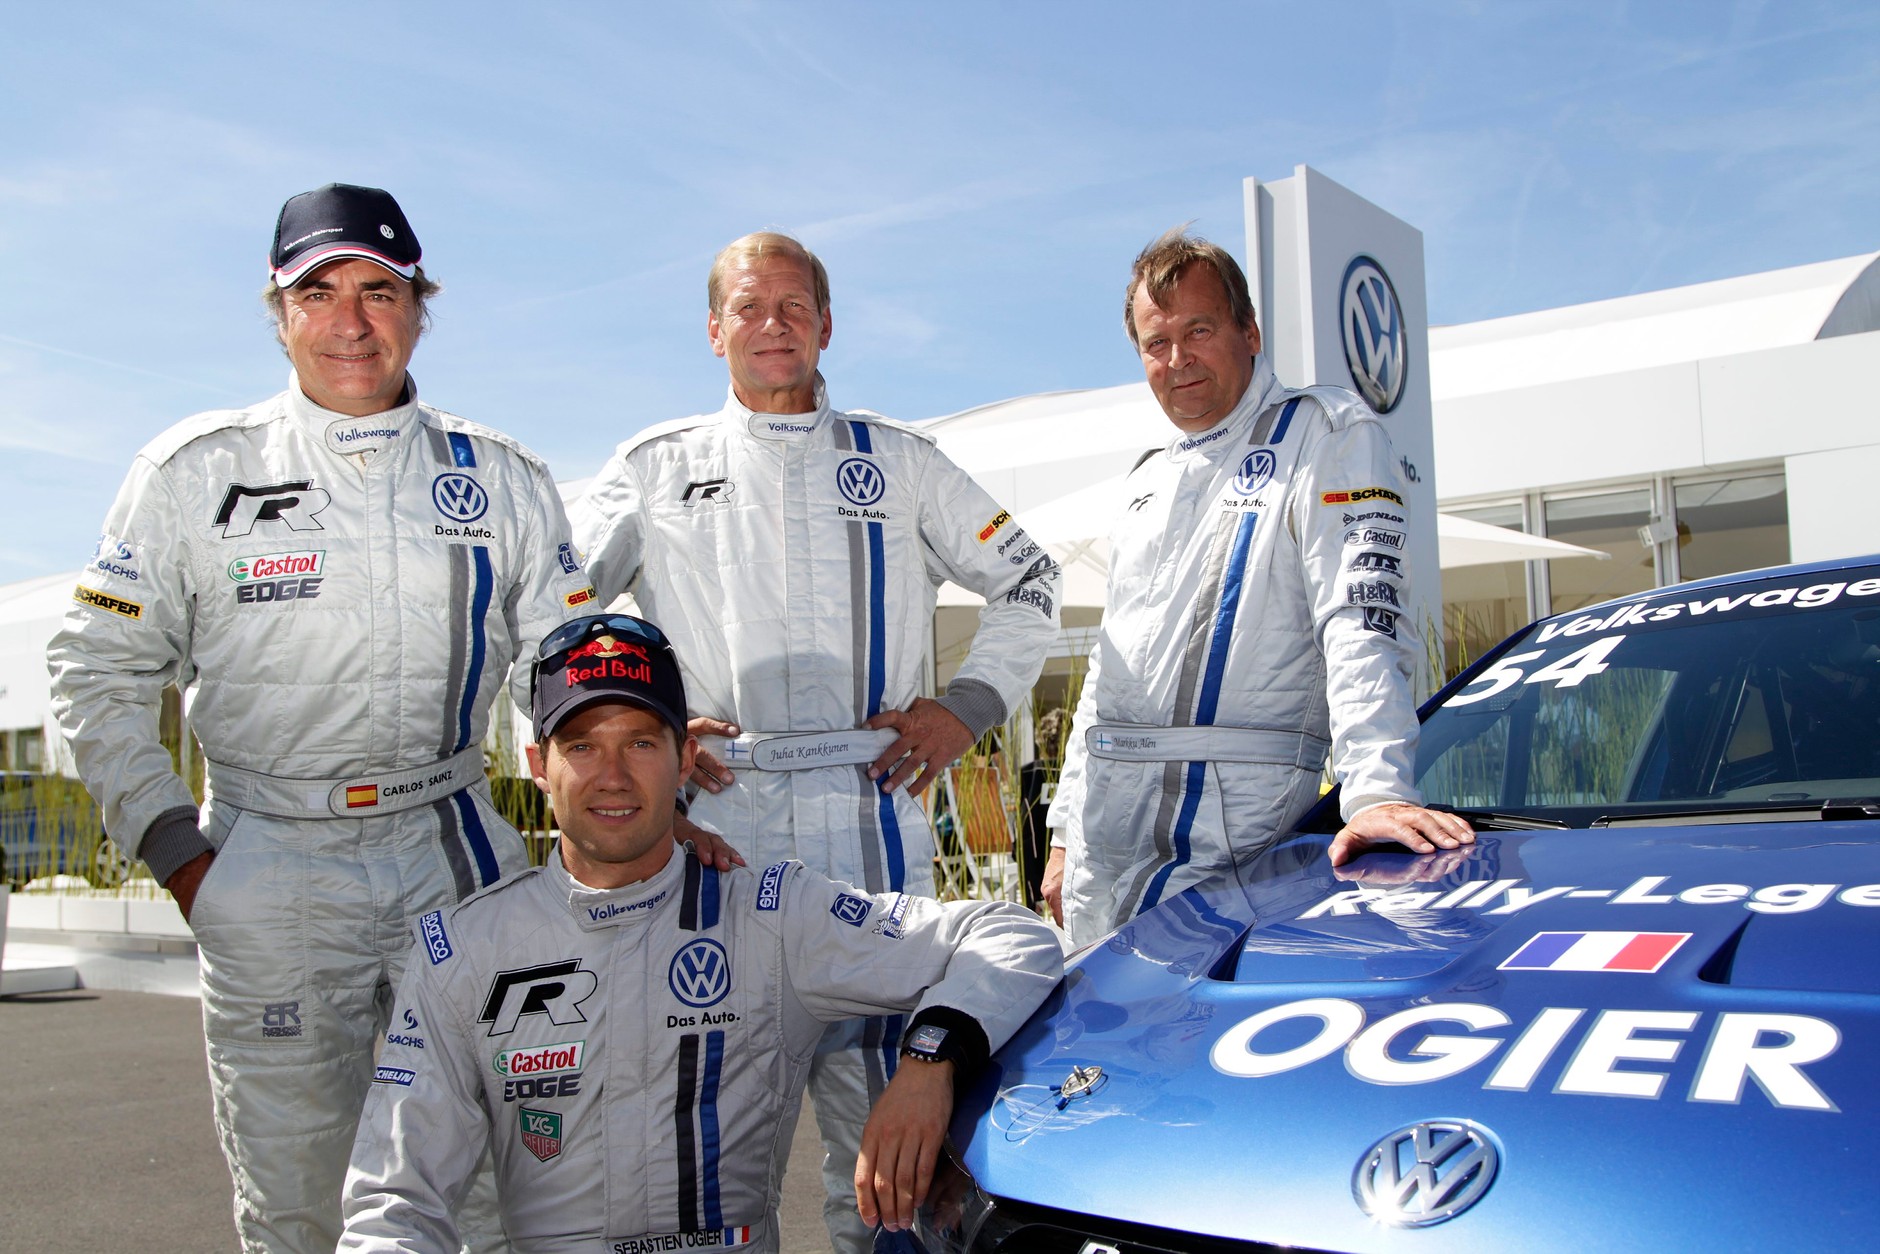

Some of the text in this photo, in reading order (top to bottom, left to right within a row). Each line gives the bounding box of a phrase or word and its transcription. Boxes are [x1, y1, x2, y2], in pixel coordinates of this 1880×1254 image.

[335, 428, 400, 442] Volkswagen
[1179, 427, 1229, 451] Volkswagen
[838, 506, 890, 520] Das Auto.
[1241, 498, 1267, 508] Auto.
[1355, 511, 1405, 523] DUNLOP
[434, 525, 496, 540] Das Auto.
[1363, 529, 1402, 548] Castrol
[97, 560, 139, 580] SACHS
[253, 554, 318, 578] Castrol
[1349, 552, 1401, 570] ATS
[236, 578, 325, 604] EDGE
[1535, 578, 1880, 643] Volkswage
[565, 660, 653, 688] Red Bull
[1441, 634, 1627, 708] 54
[769, 742, 849, 762] Juha Kankkunen
[383, 770, 453, 797] CARLOS SAINZ
[588, 890, 667, 921] Volkswagen
[1293, 874, 1880, 921] Rally-Lege
[424, 912, 450, 960] sparco
[666, 1011, 741, 1028] Das Auto.
[387, 1033, 425, 1049] SACHS
[511, 1045, 577, 1074] Castrol
[1208, 997, 1841, 1113] OGIER
[374, 1068, 414, 1083] CHELIN
[504, 1072, 584, 1102] EDGE
[526, 1114, 555, 1136] TAG
[523, 1134, 559, 1157] HEUER
[613, 1229, 723, 1254] SEBASTIEN OGIER
